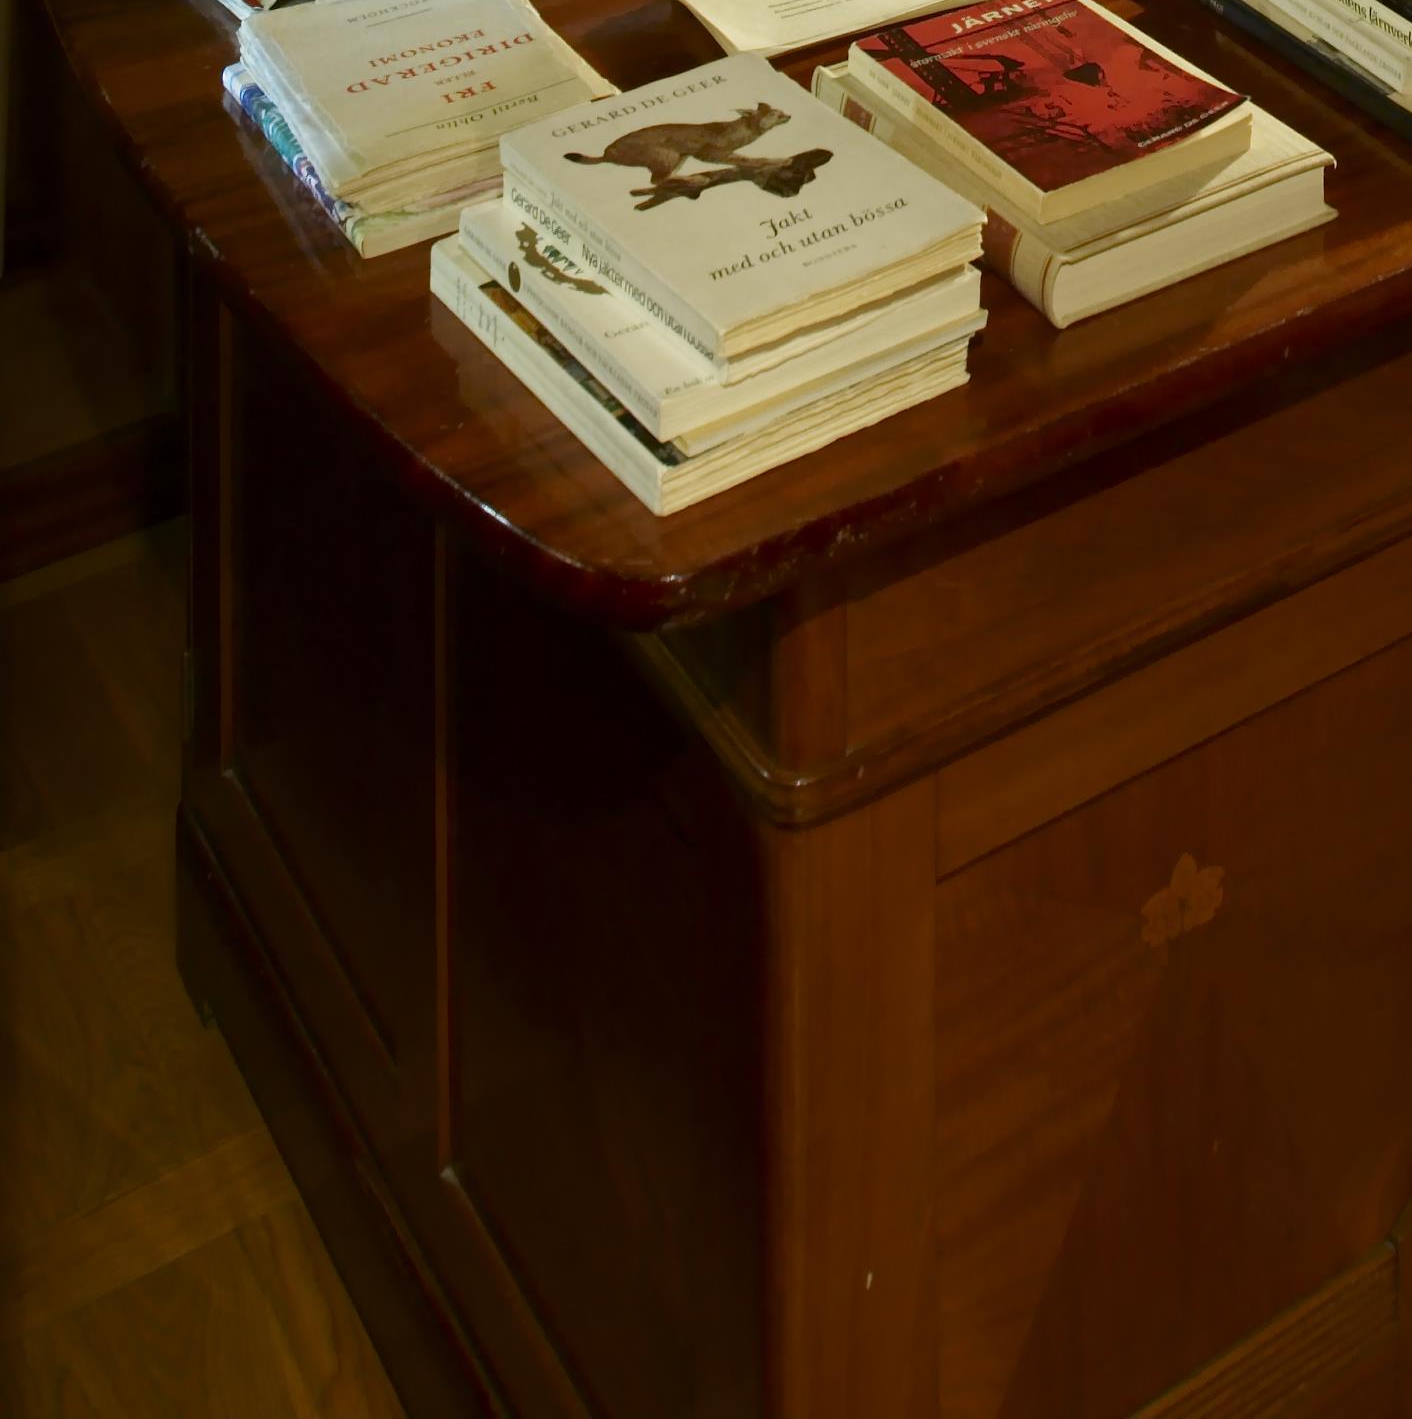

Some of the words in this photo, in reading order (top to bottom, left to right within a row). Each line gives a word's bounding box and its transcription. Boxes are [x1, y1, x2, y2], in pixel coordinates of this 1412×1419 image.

[368, 28, 485, 68] EKONOMI
[975, 29, 1020, 50] svenskt
[346, 32, 536, 94] DIRIGERAD
[441, 80, 497, 104] FRI
[492, 94, 540, 116] Bertil
[551, 104, 639, 139] GERARD
[641, 94, 668, 110] DE
[672, 74, 729, 101] GEER
[436, 113, 484, 130] Ohlin
[511, 187, 539, 220] Gerard
[539, 210, 551, 229] De
[551, 217, 572, 246] Geer
[582, 243, 599, 268] Nya
[709, 253, 753, 283] med
[759, 239, 794, 264] och
[798, 222, 849, 251] utan
[851, 195, 910, 229] bössa
[759, 207, 814, 239] Jakt
